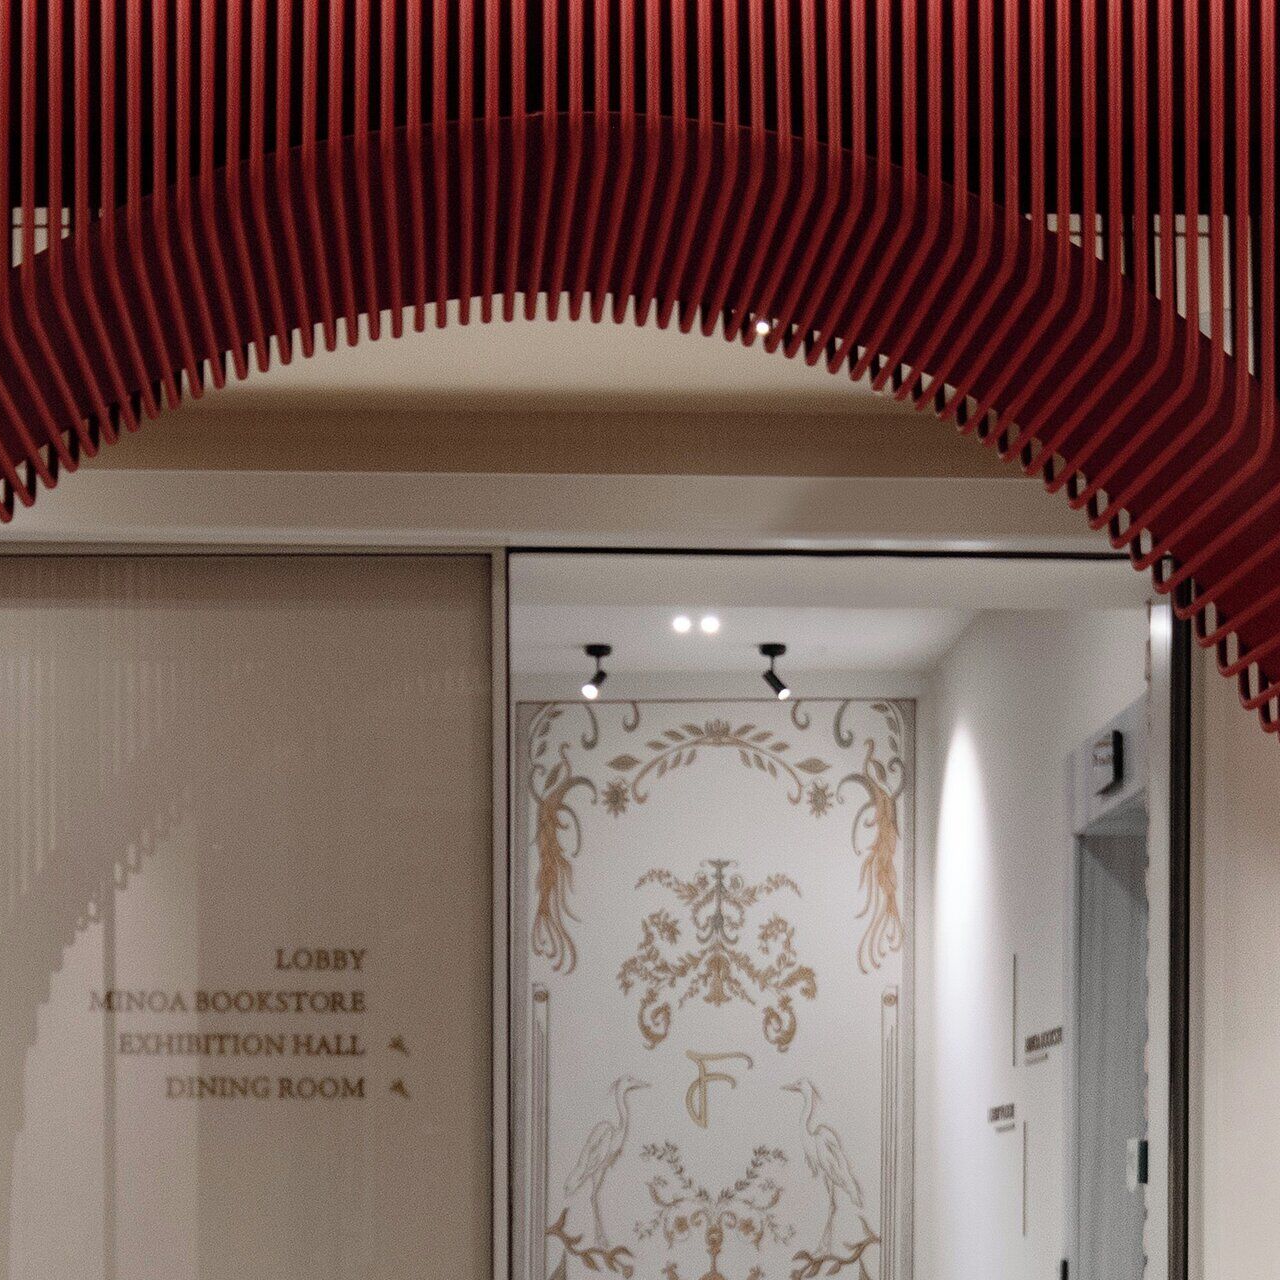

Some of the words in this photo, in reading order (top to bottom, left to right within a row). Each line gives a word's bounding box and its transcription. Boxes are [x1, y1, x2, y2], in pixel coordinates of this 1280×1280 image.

[275, 949, 367, 971] LOBBY
[88, 990, 187, 1013] MINOA
[194, 990, 366, 1014] BOOKSTORE
[120, 1033, 284, 1056] EXHIBITION
[293, 1033, 365, 1056] HALL
[166, 1076, 270, 1100] DINING
[278, 1076, 366, 1099] ROOM
